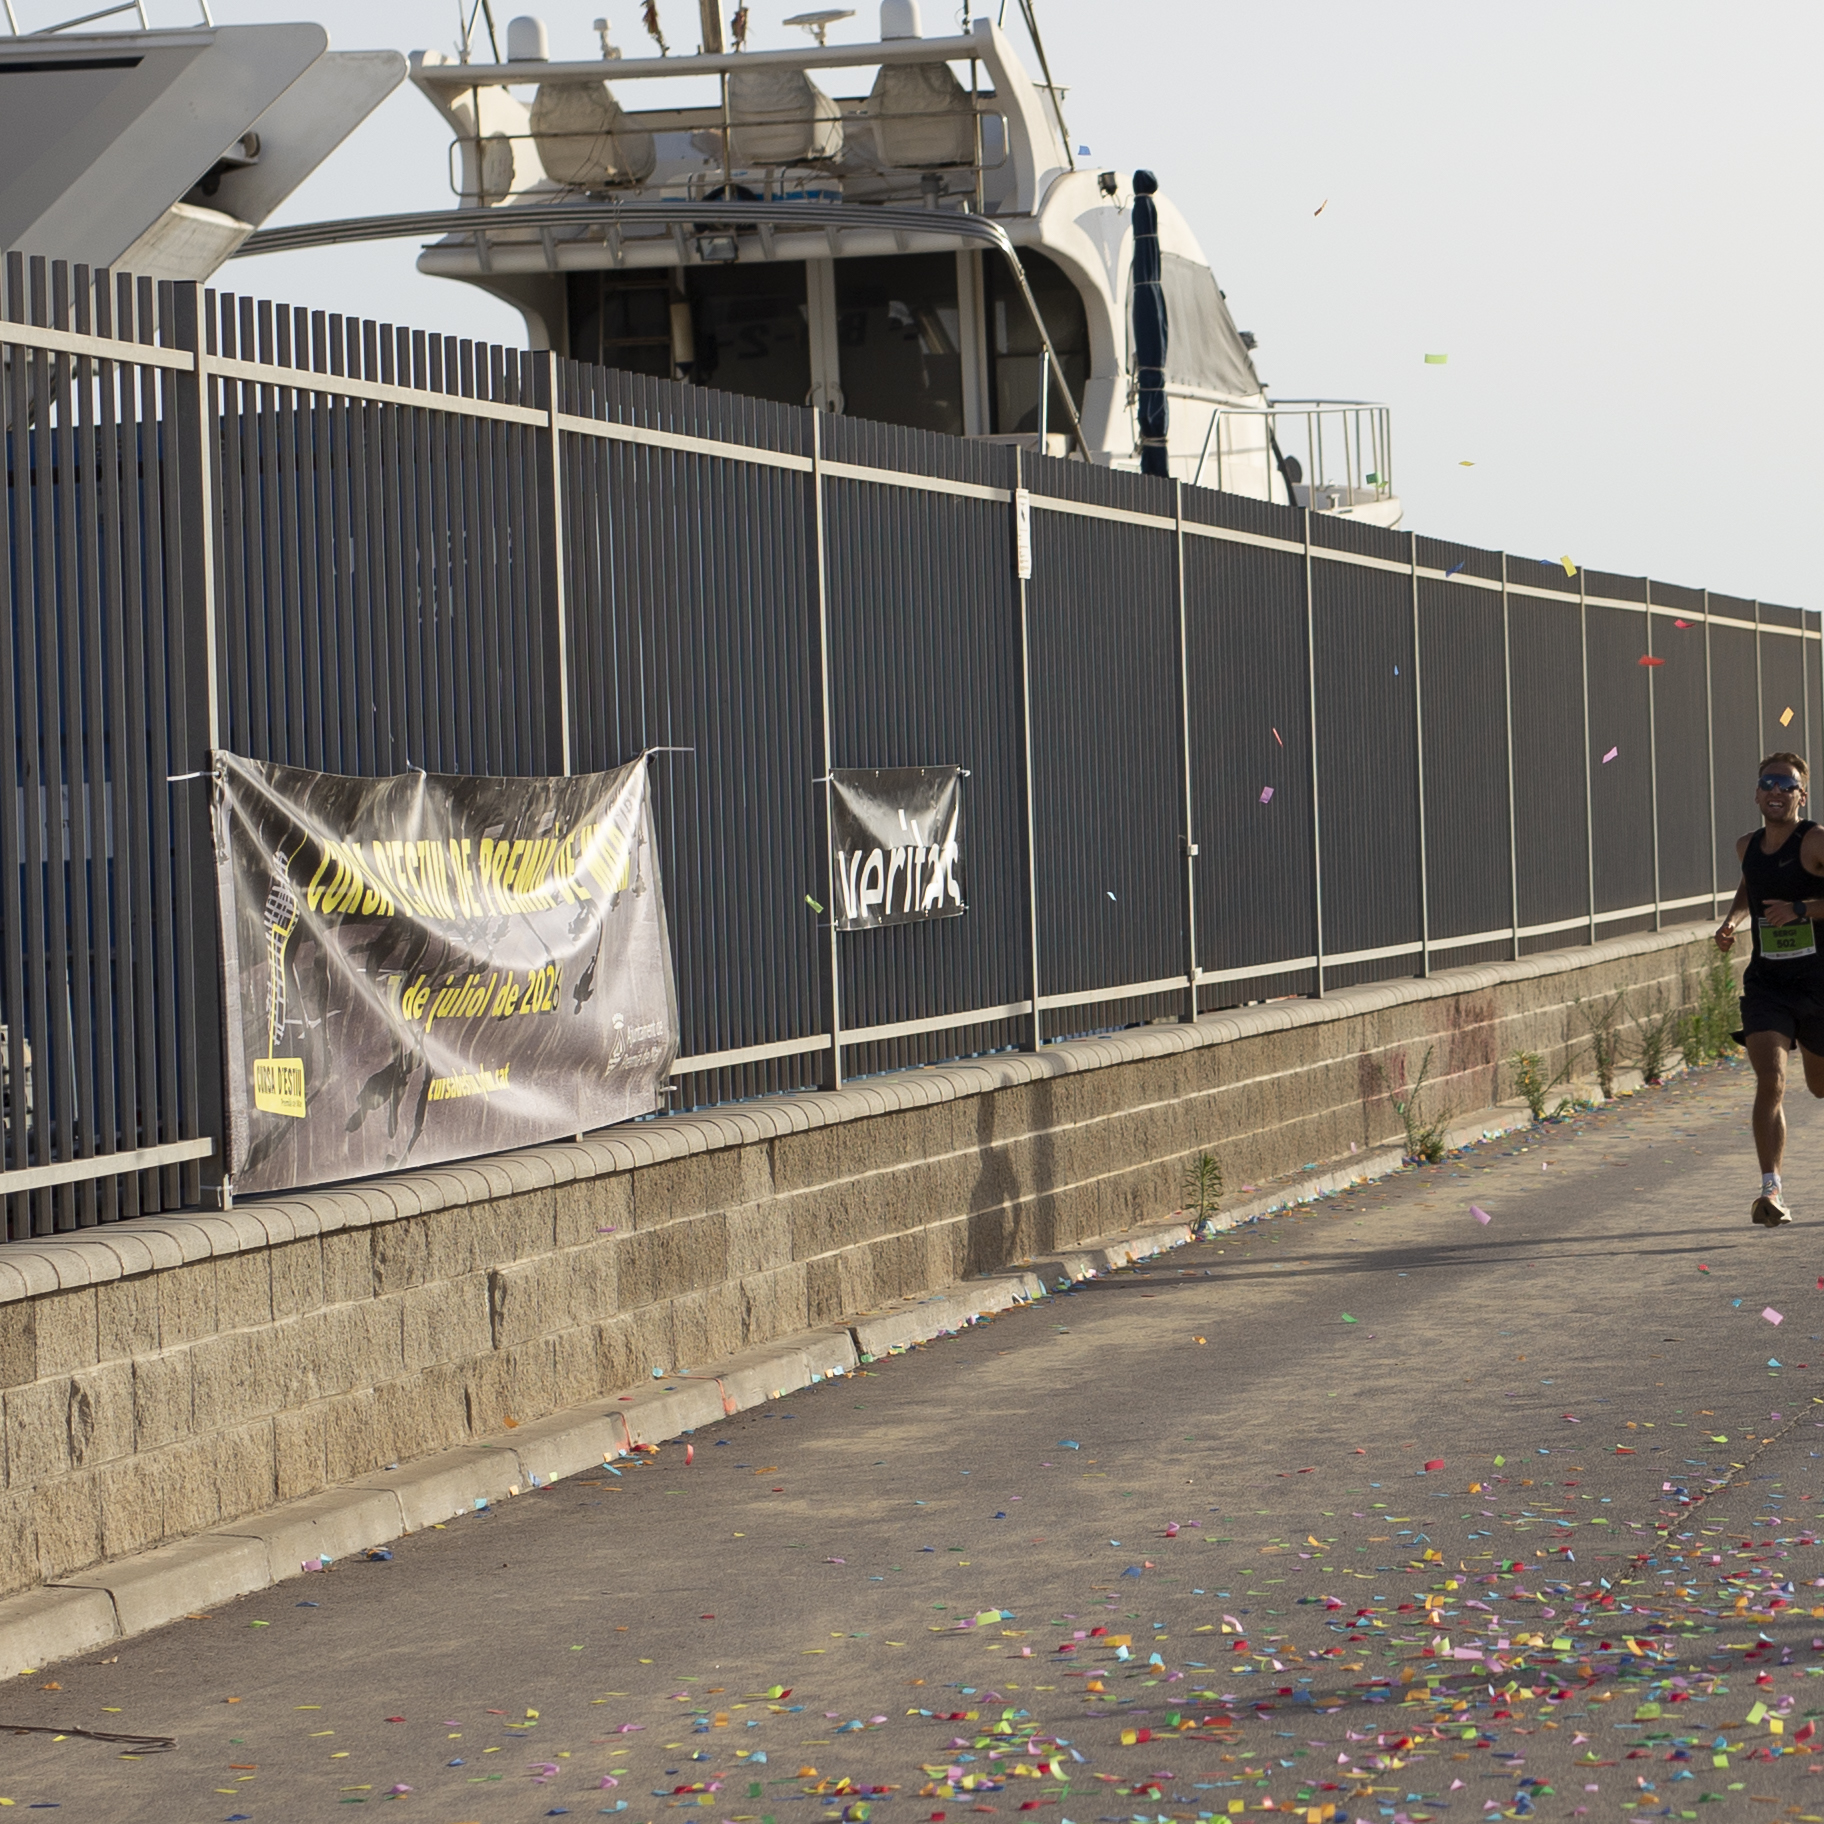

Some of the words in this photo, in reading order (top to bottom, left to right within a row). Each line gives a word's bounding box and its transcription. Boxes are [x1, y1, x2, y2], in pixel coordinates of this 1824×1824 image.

[449, 837, 484, 920] DE
[1776, 938, 1797, 949] 502
[402, 973, 431, 1022] de
[425, 972, 498, 1034] juliol
[491, 970, 520, 1018] de
[519, 964, 564, 1015] 2026
